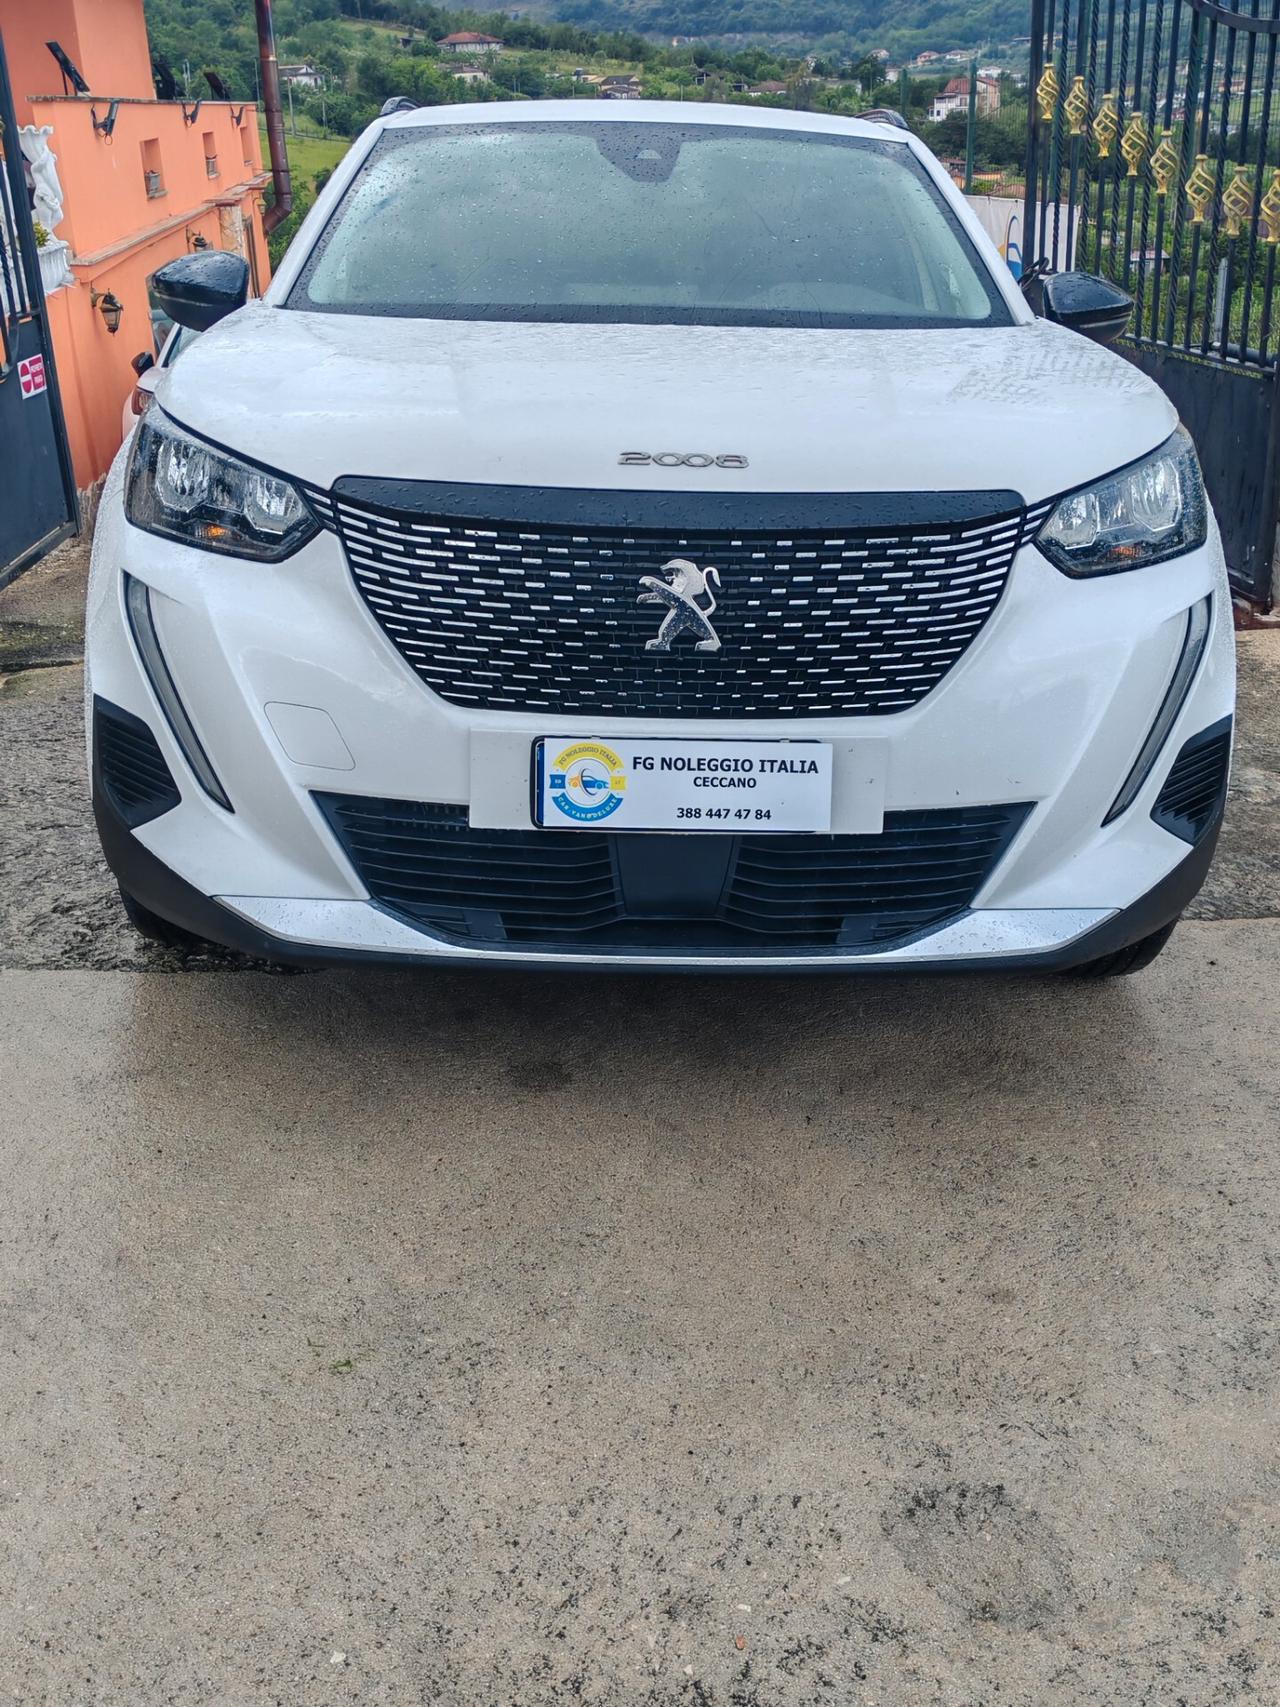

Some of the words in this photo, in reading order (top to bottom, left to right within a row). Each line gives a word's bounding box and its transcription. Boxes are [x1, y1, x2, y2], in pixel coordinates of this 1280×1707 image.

[617, 452, 749, 468] 2008
[632, 756, 655, 770] FG
[660, 757, 754, 772] NOLEGGIO
[758, 759, 819, 774] ITALIA
[693, 776, 757, 788] CECCANO
[676, 807, 701, 819] 388
[705, 808, 730, 819] 447
[734, 809, 751, 820] 47
[755, 809, 771, 820] 84
